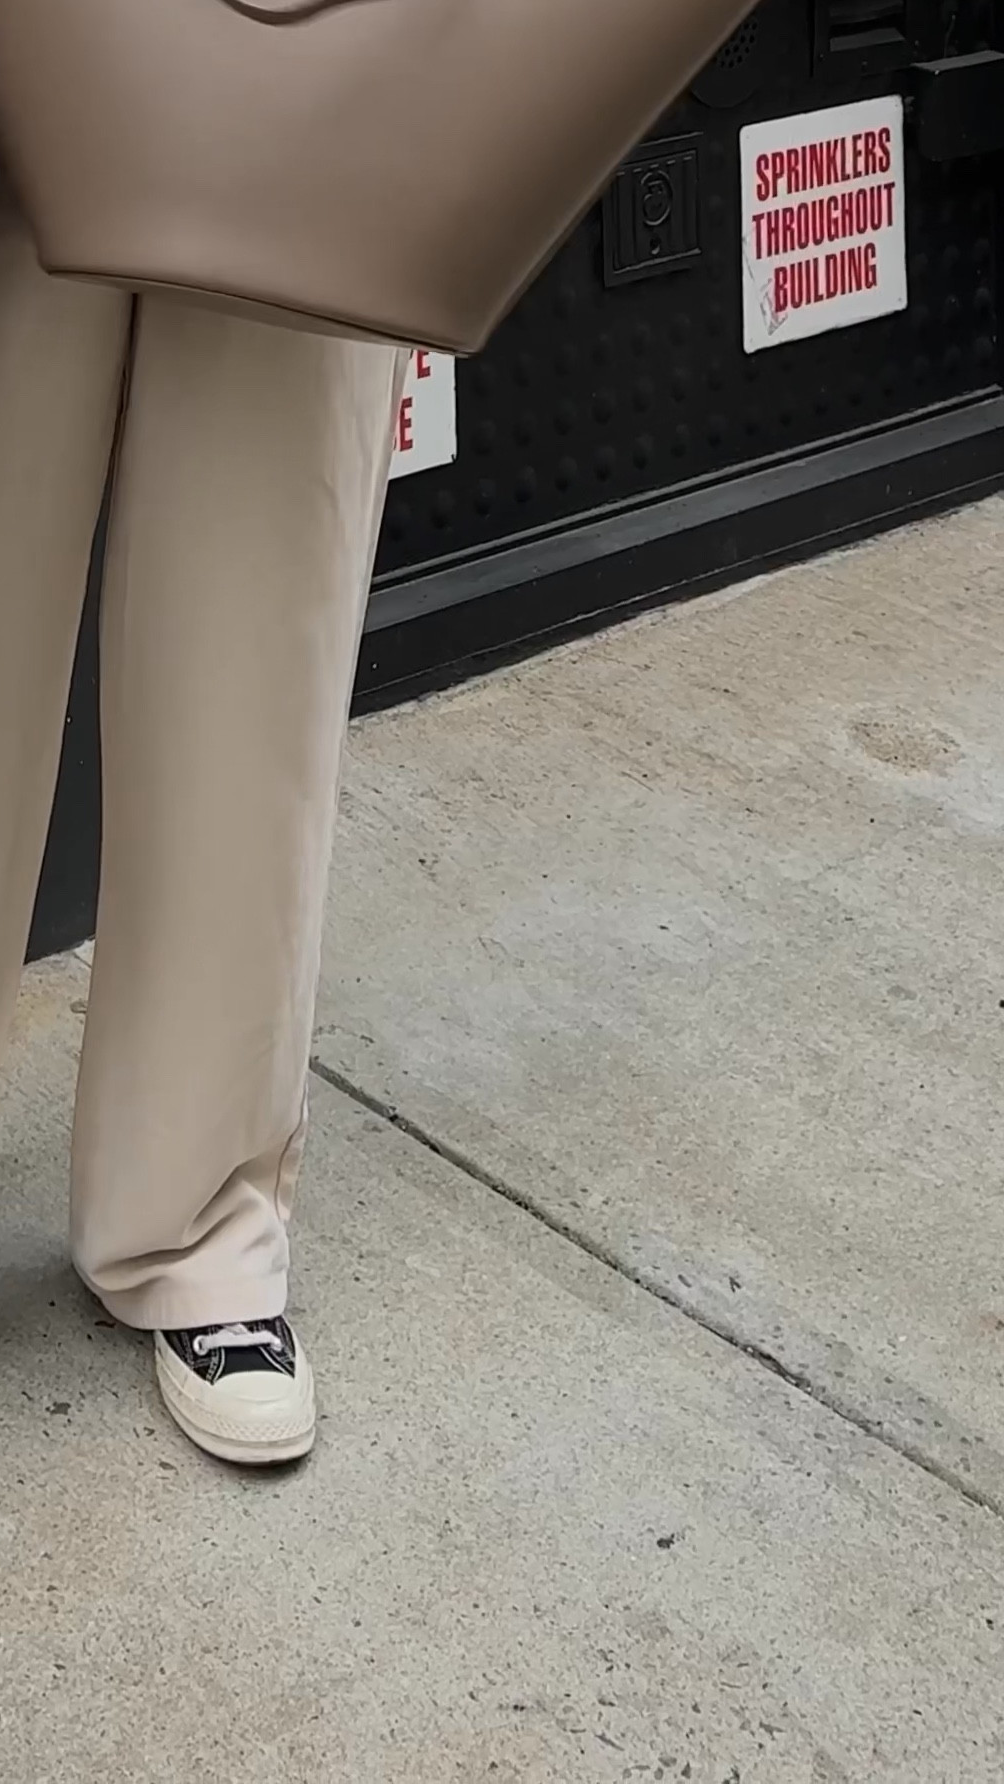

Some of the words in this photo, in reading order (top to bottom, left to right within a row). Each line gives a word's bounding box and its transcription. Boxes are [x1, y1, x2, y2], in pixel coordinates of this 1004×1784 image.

[756, 127, 891, 202] SPRINKLERS
[752, 182, 895, 260] THROUGHOUT
[773, 243, 877, 313] BUILDING
